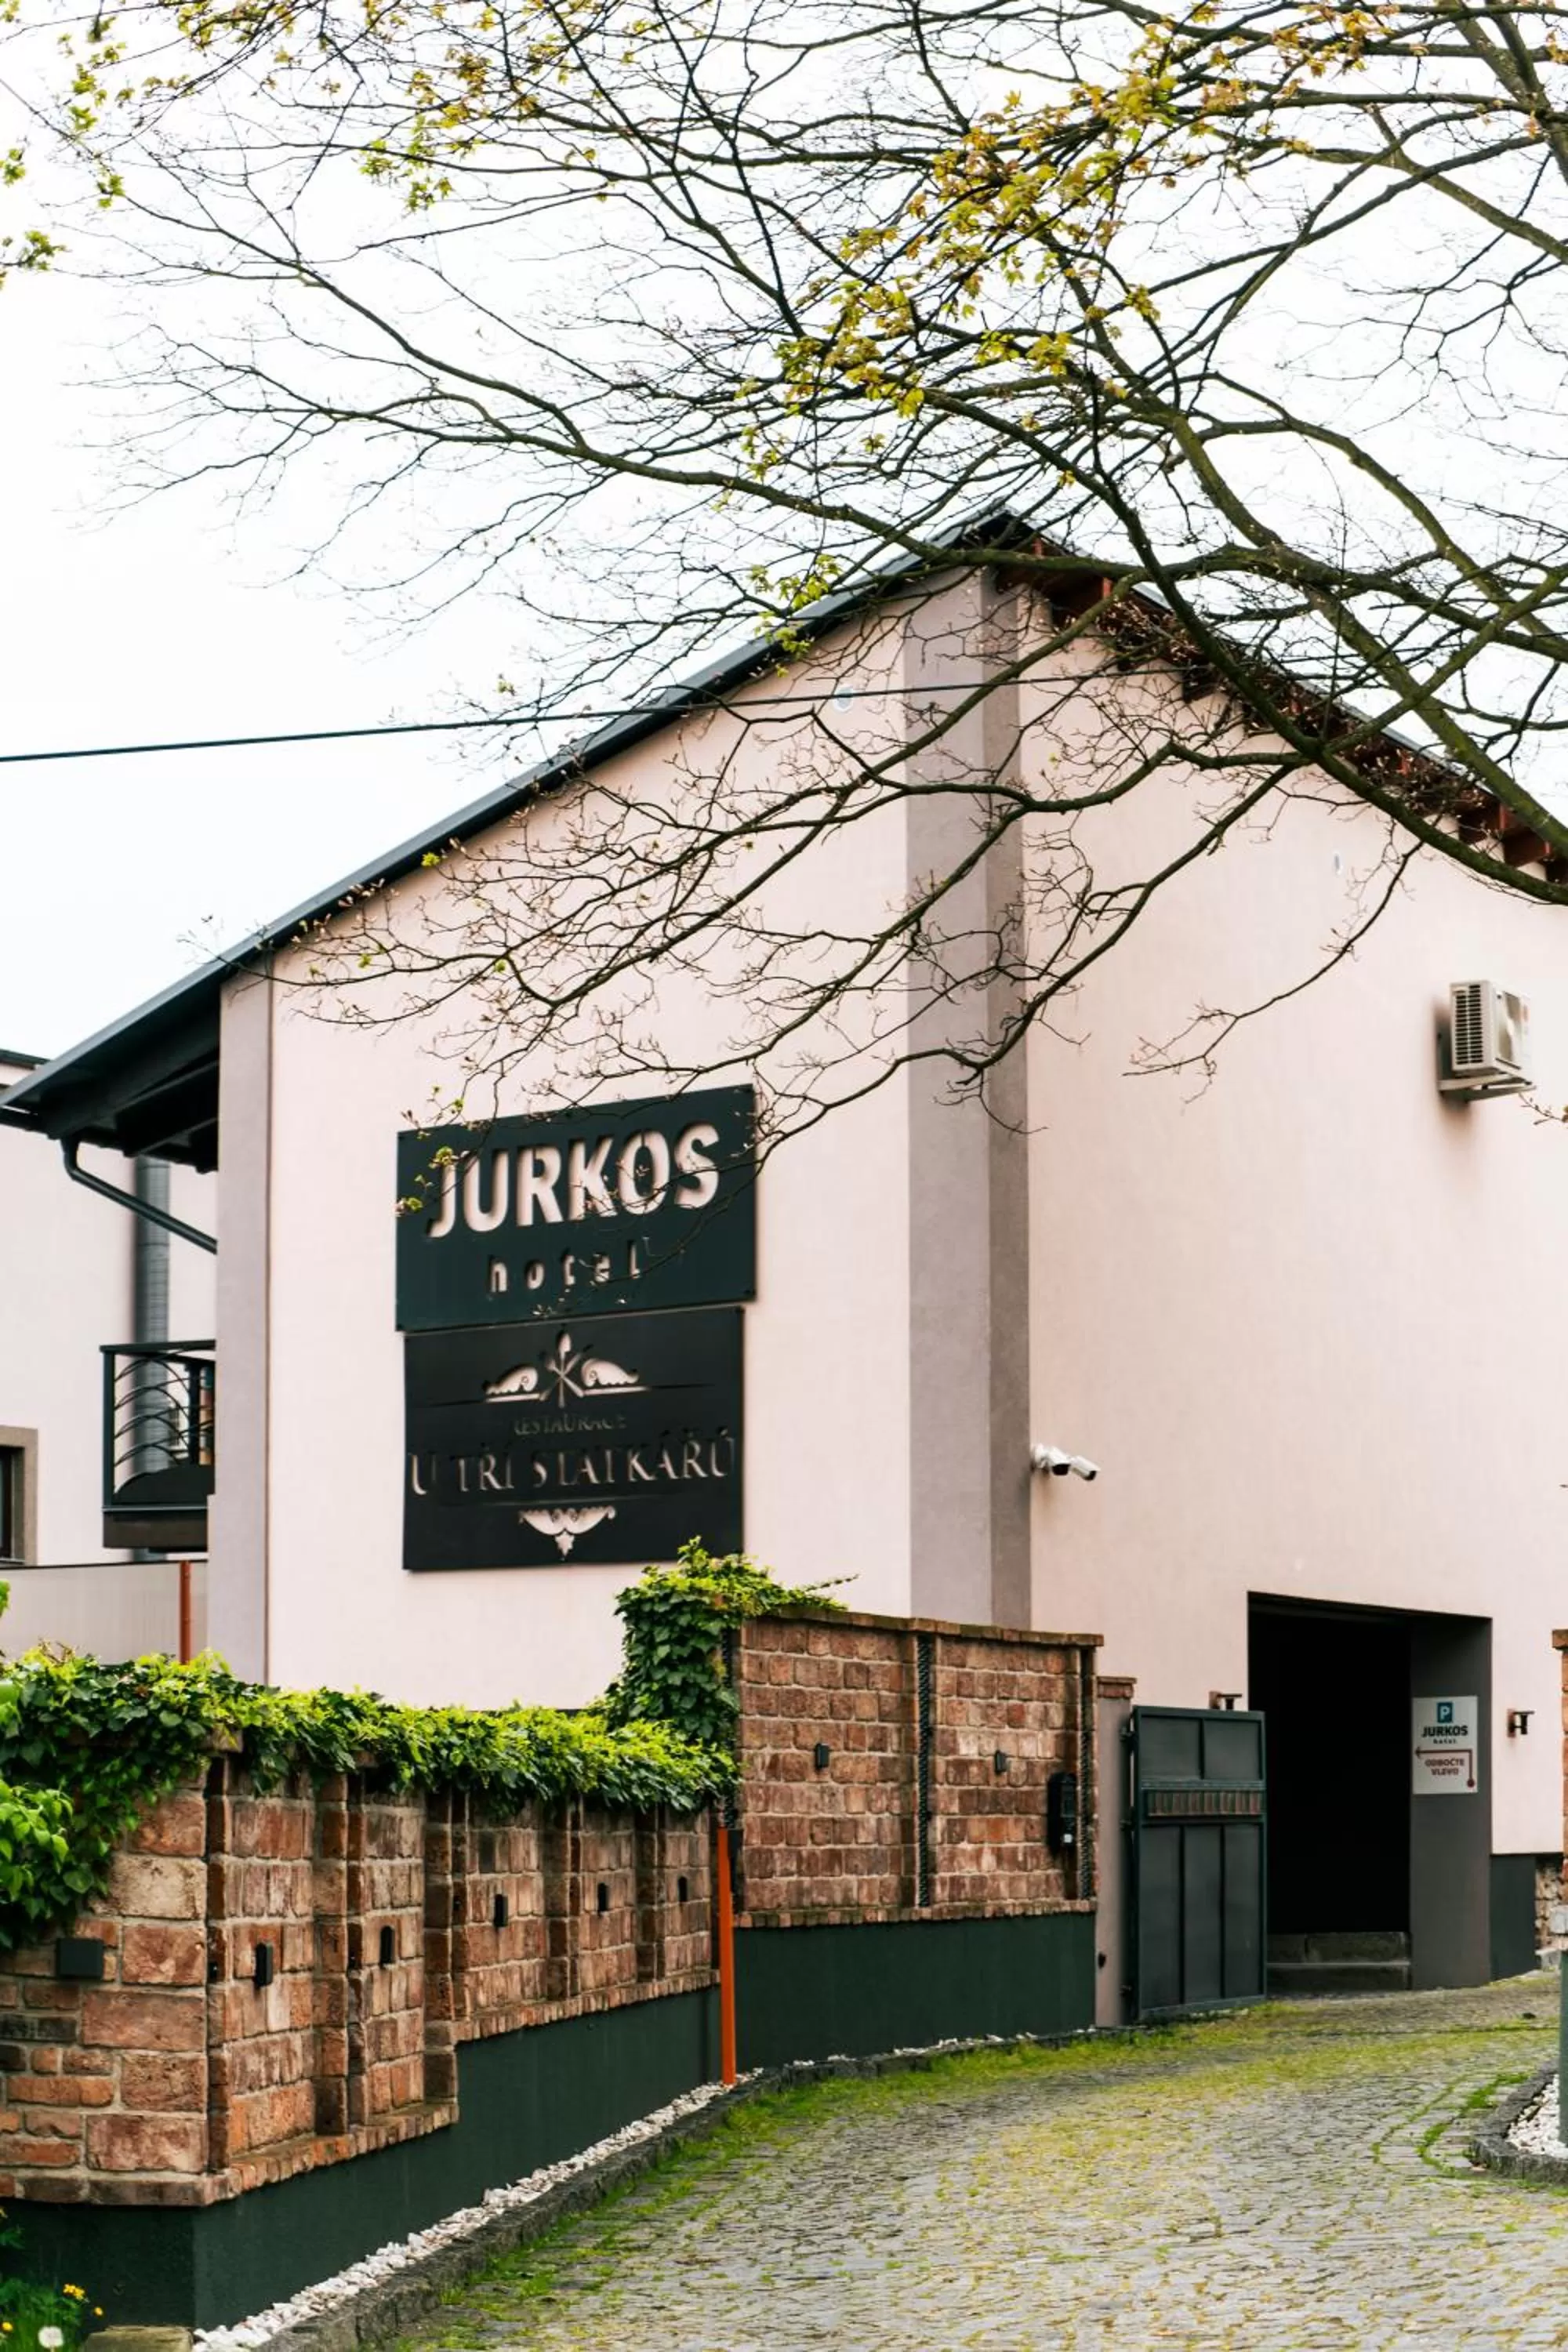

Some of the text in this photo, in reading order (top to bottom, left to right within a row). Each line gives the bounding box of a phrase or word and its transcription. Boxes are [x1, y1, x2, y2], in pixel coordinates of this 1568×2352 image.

[427, 1122, 720, 1239] JURKOS
[488, 1240, 642, 1293] hotel
[408, 1450, 437, 1495] U
[1421, 1725, 1468, 1738] JURKOS
[1440, 1705, 1450, 1720] P
